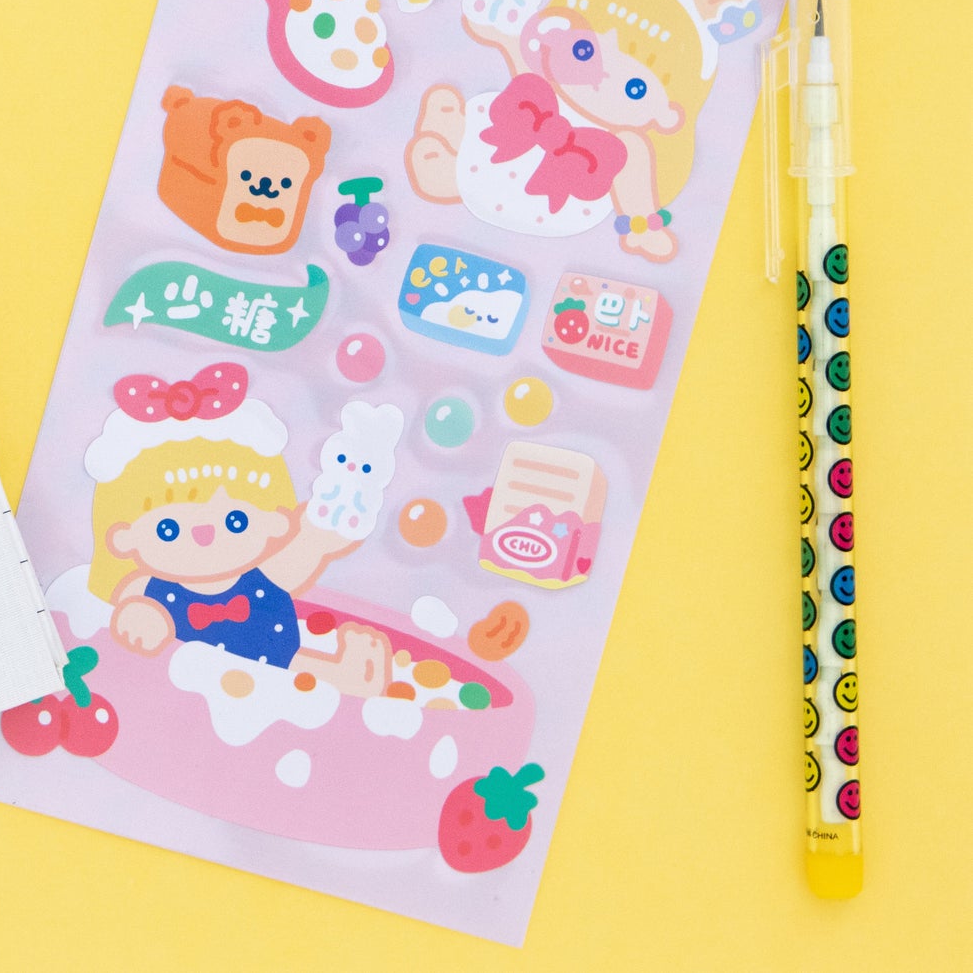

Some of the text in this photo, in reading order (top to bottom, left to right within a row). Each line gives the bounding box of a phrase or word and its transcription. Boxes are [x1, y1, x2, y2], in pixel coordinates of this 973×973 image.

[587, 333, 639, 359] NICE
[509, 538, 542, 556] CHU
[812, 830, 840, 841] CHINA
